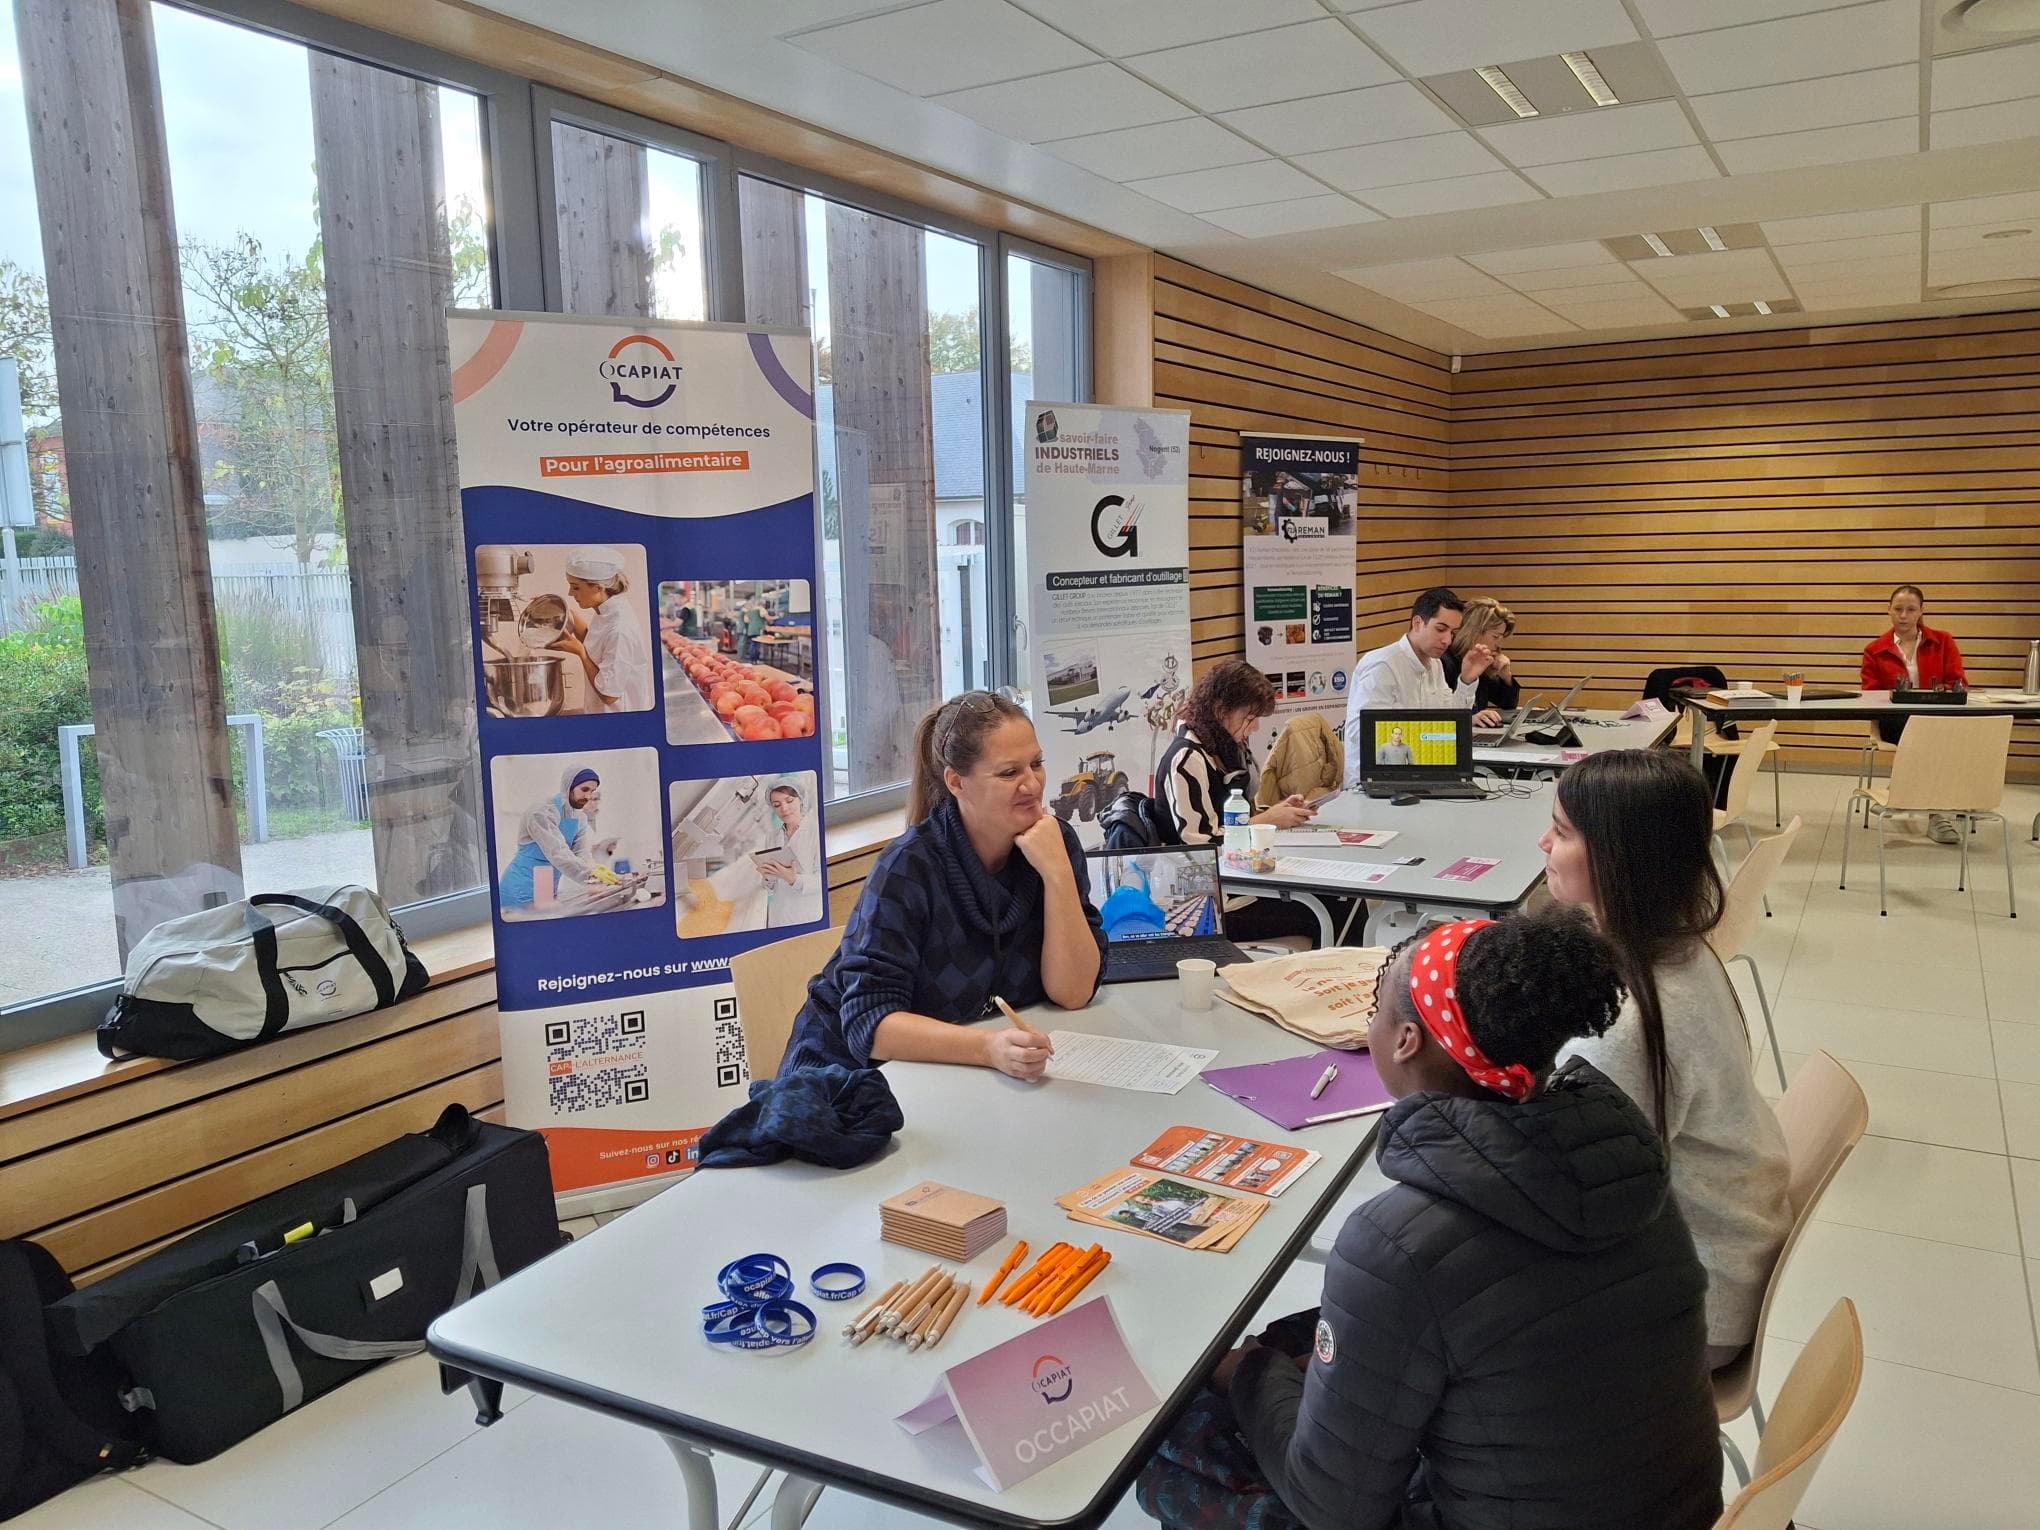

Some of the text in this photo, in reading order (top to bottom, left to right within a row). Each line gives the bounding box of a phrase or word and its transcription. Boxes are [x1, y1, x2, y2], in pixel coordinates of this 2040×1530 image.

[599, 360, 683, 381] OCAPIAT
[507, 418, 771, 439] Votre opérateur de compétences
[1059, 432, 1119, 445] savoir-faire
[1035, 446, 1120, 461] INDUSTRIELS
[1255, 447, 1345, 463] REJOIGNEZ-NOUS
[545, 452, 743, 475] Pour l'agroalimentaire
[1036, 462, 1120, 475] de Haute-Marne
[1297, 526, 1325, 535] REMAN
[1052, 570, 1183, 588] Concepteur et fabricant d'outillage
[537, 965, 661, 992] Rejoignez-nous
[663, 960, 688, 975] sur
[599, 1144, 654, 1160] Suivez-nous
[655, 1140, 670, 1150] sur
[672, 1138, 688, 1147] nos
[1015, 1386, 1133, 1464] OCCAPIAT
